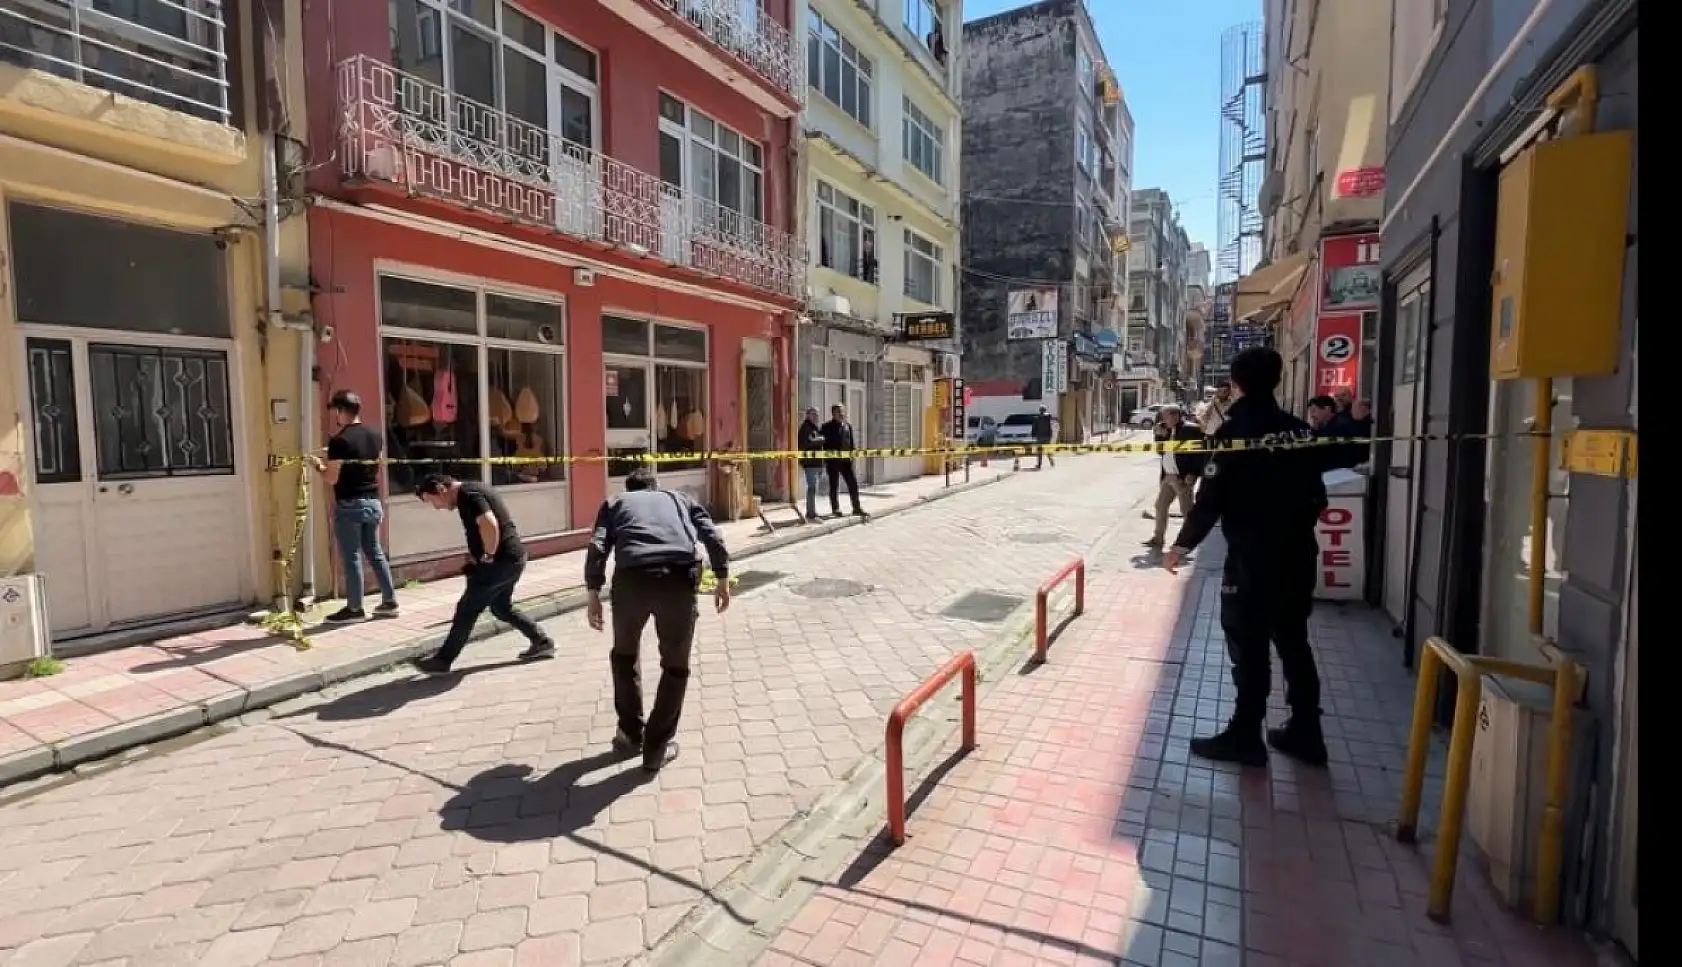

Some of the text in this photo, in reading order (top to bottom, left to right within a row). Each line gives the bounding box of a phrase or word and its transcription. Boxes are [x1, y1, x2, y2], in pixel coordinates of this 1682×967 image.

[1327, 337, 1349, 358] 2
[1320, 367, 1352, 386] EL
[1320, 508, 1352, 587] OTEL
